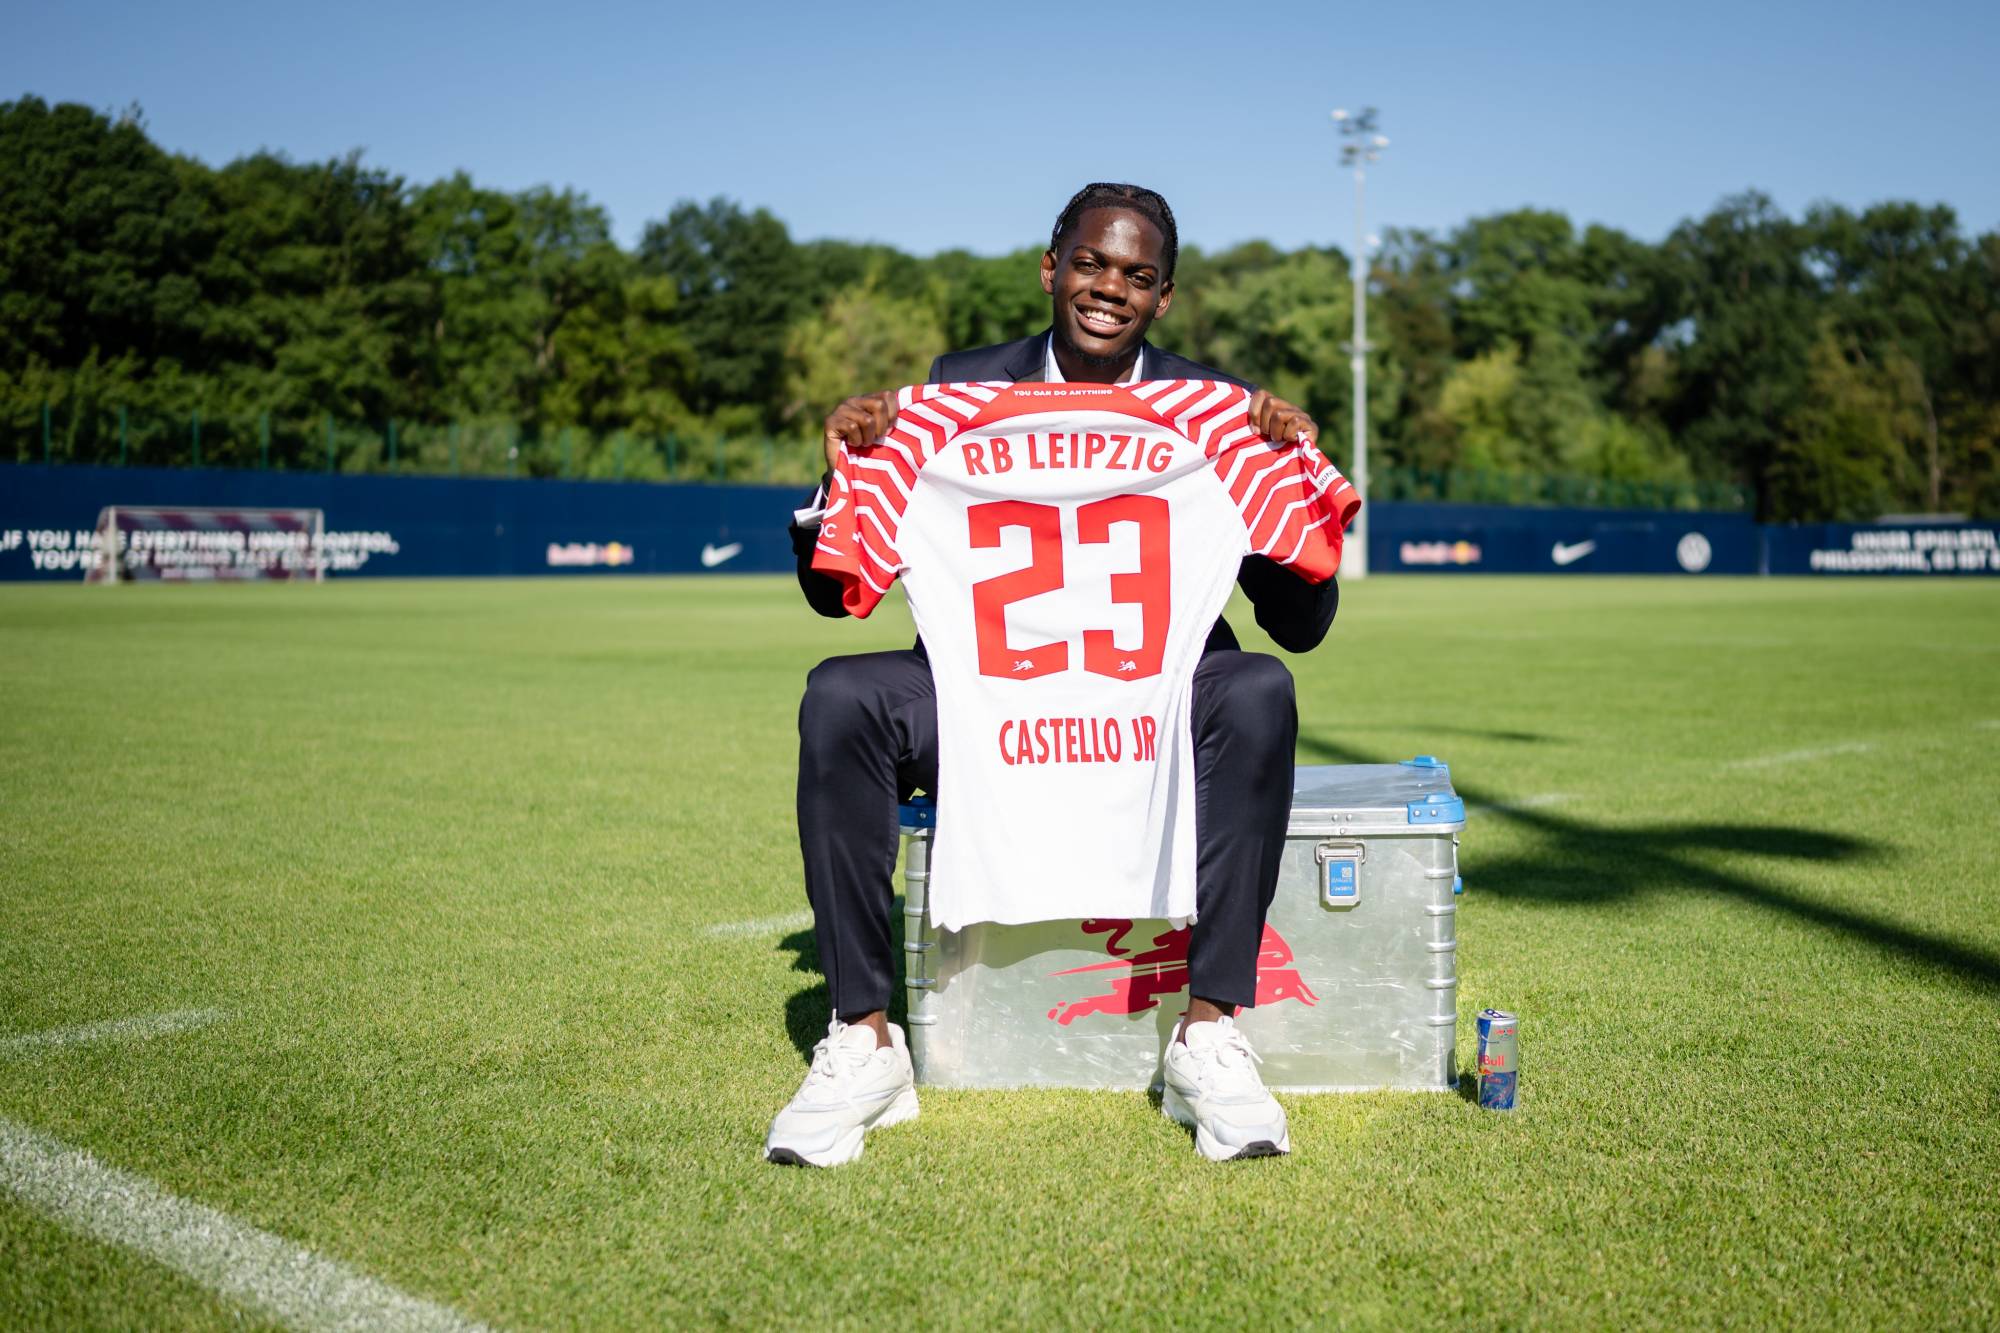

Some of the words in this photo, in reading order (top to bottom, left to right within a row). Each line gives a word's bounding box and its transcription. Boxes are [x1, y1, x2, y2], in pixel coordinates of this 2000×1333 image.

[961, 437, 1013, 476] RB
[1027, 433, 1175, 473] LEIPZIG
[27, 530, 71, 550] YOU
[967, 494, 1171, 681] 23
[999, 717, 1122, 765] CASTELLO
[1132, 716, 1157, 762] JR
